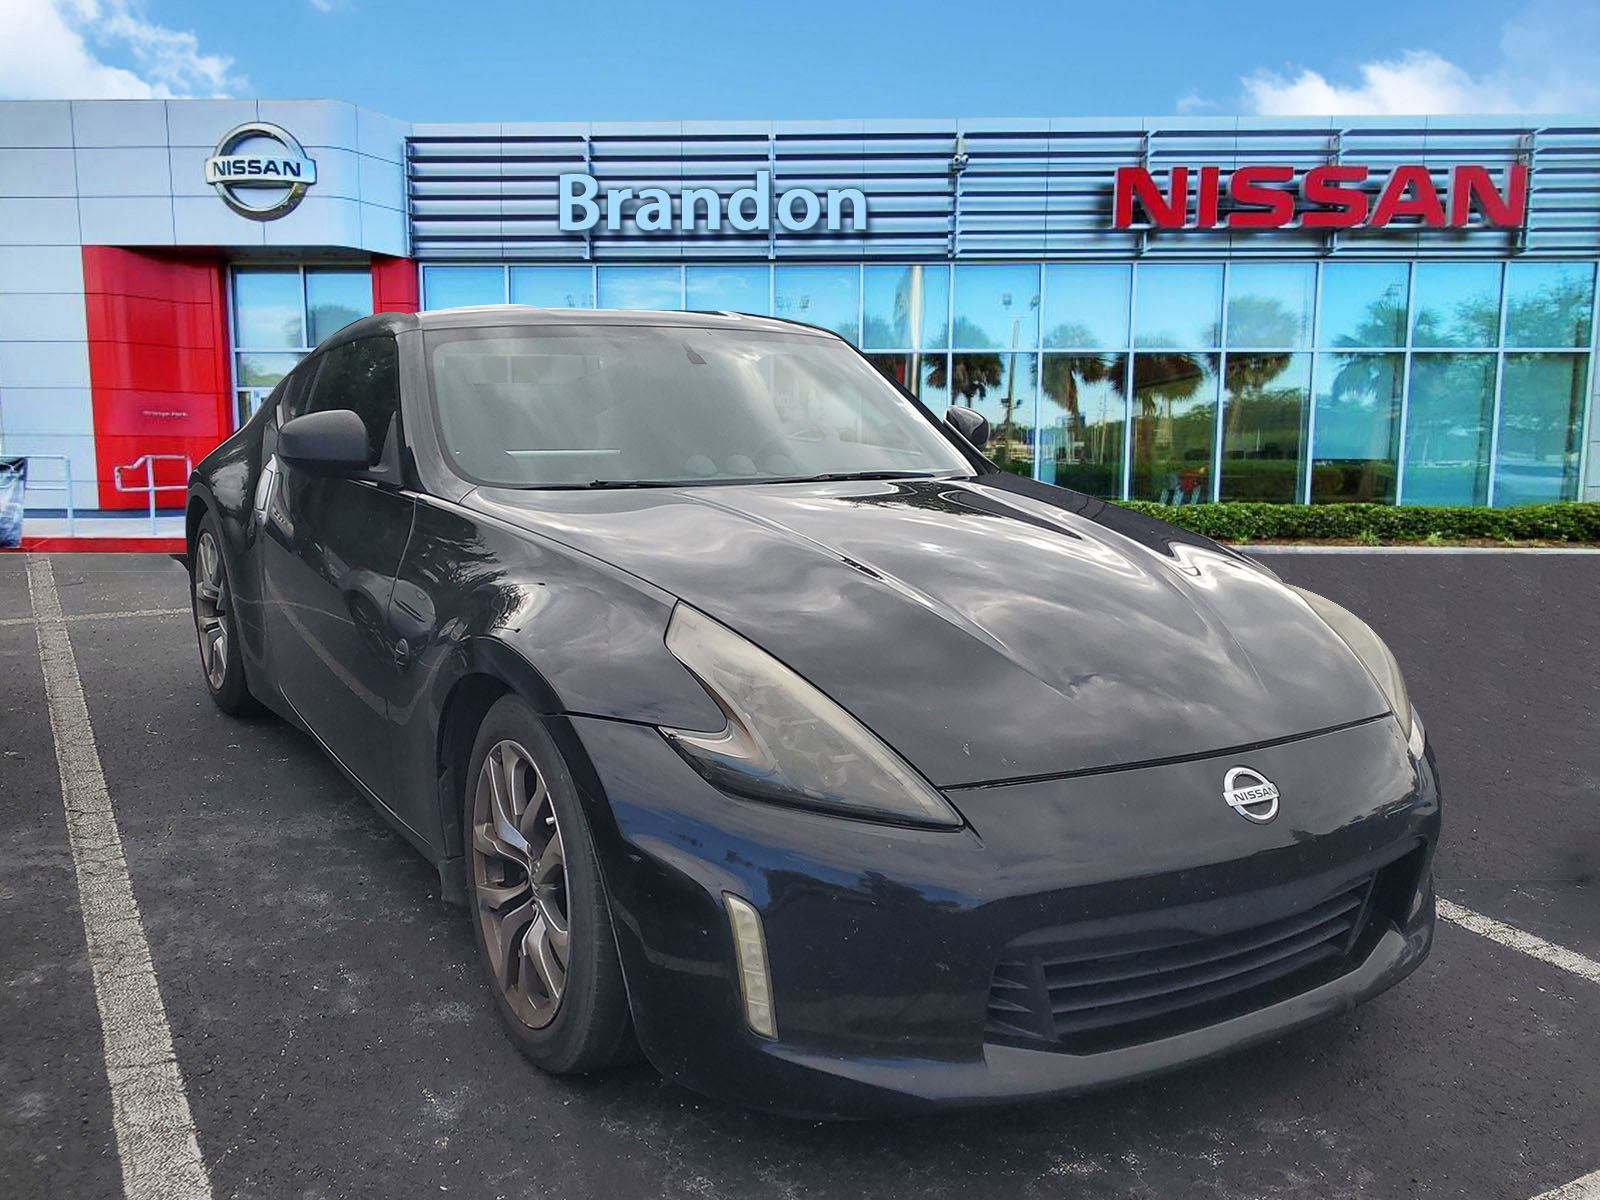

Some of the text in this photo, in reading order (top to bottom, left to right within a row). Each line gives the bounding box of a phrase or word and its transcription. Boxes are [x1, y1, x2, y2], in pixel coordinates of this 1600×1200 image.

[213, 159, 301, 177] NISSAN
[559, 170, 867, 231] Brandon
[1113, 165, 1528, 229] NISSAN
[1233, 787, 1277, 801] NISSAN
